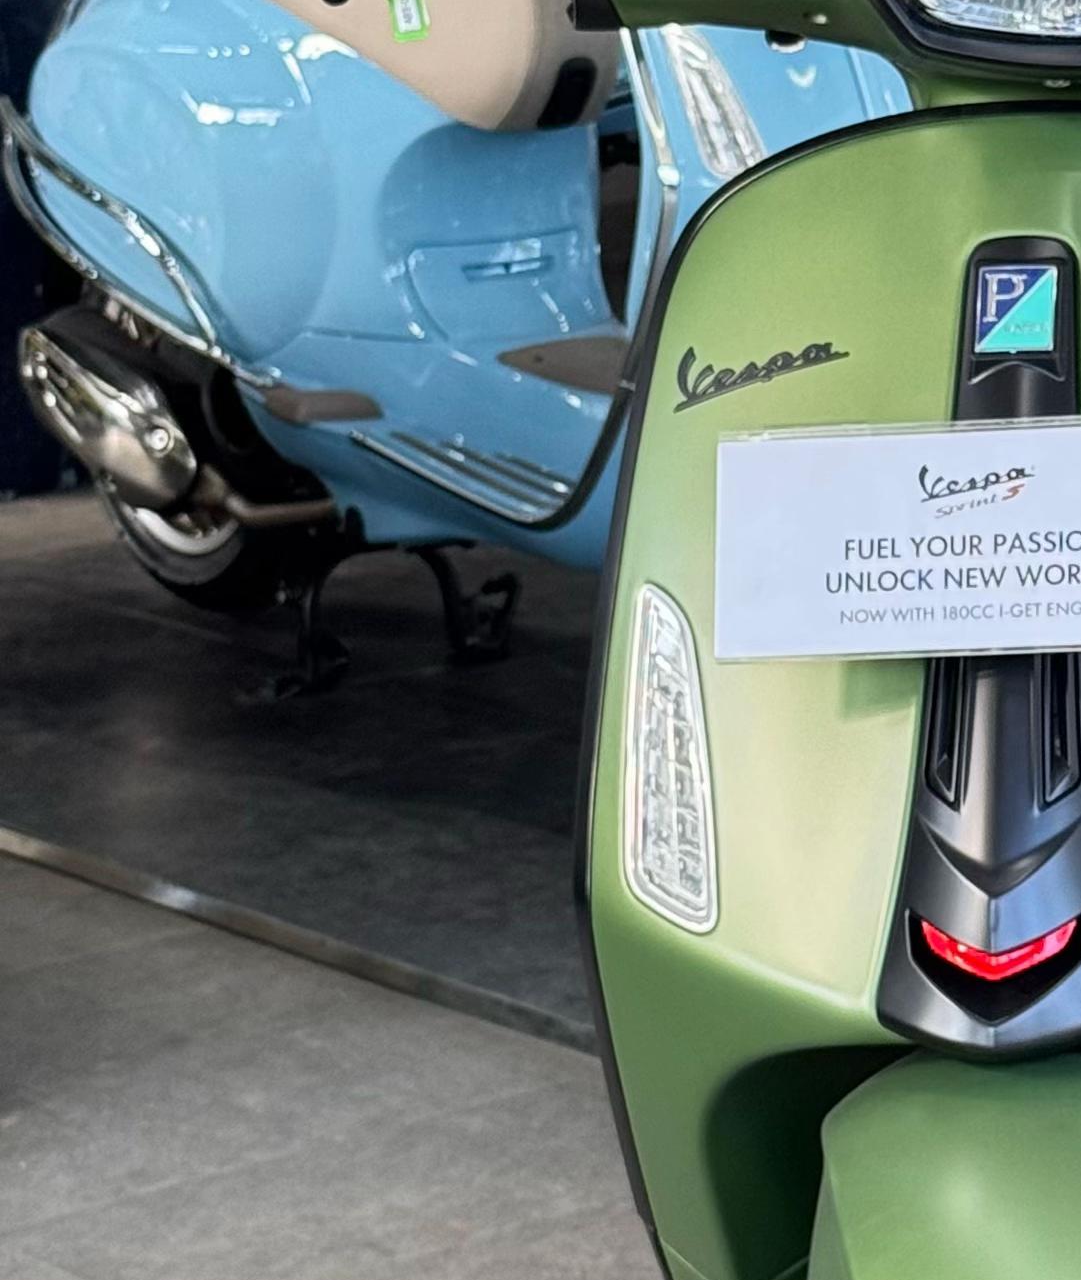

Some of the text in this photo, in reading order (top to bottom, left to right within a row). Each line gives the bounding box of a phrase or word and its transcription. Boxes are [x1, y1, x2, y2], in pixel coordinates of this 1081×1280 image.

[673, 341, 851, 414] Vespa
[918, 464, 1036, 503] Vespa
[844, 537, 902, 561] FUEL
[909, 533, 983, 559] YOUR
[826, 568, 935, 595] UNLOCK
[943, 564, 1008, 591] NEW
[840, 608, 888, 624] NOW
[891, 605, 936, 623] WITH
[942, 603, 995, 621] 180CC
[1000, 601, 1042, 618] I-GET
